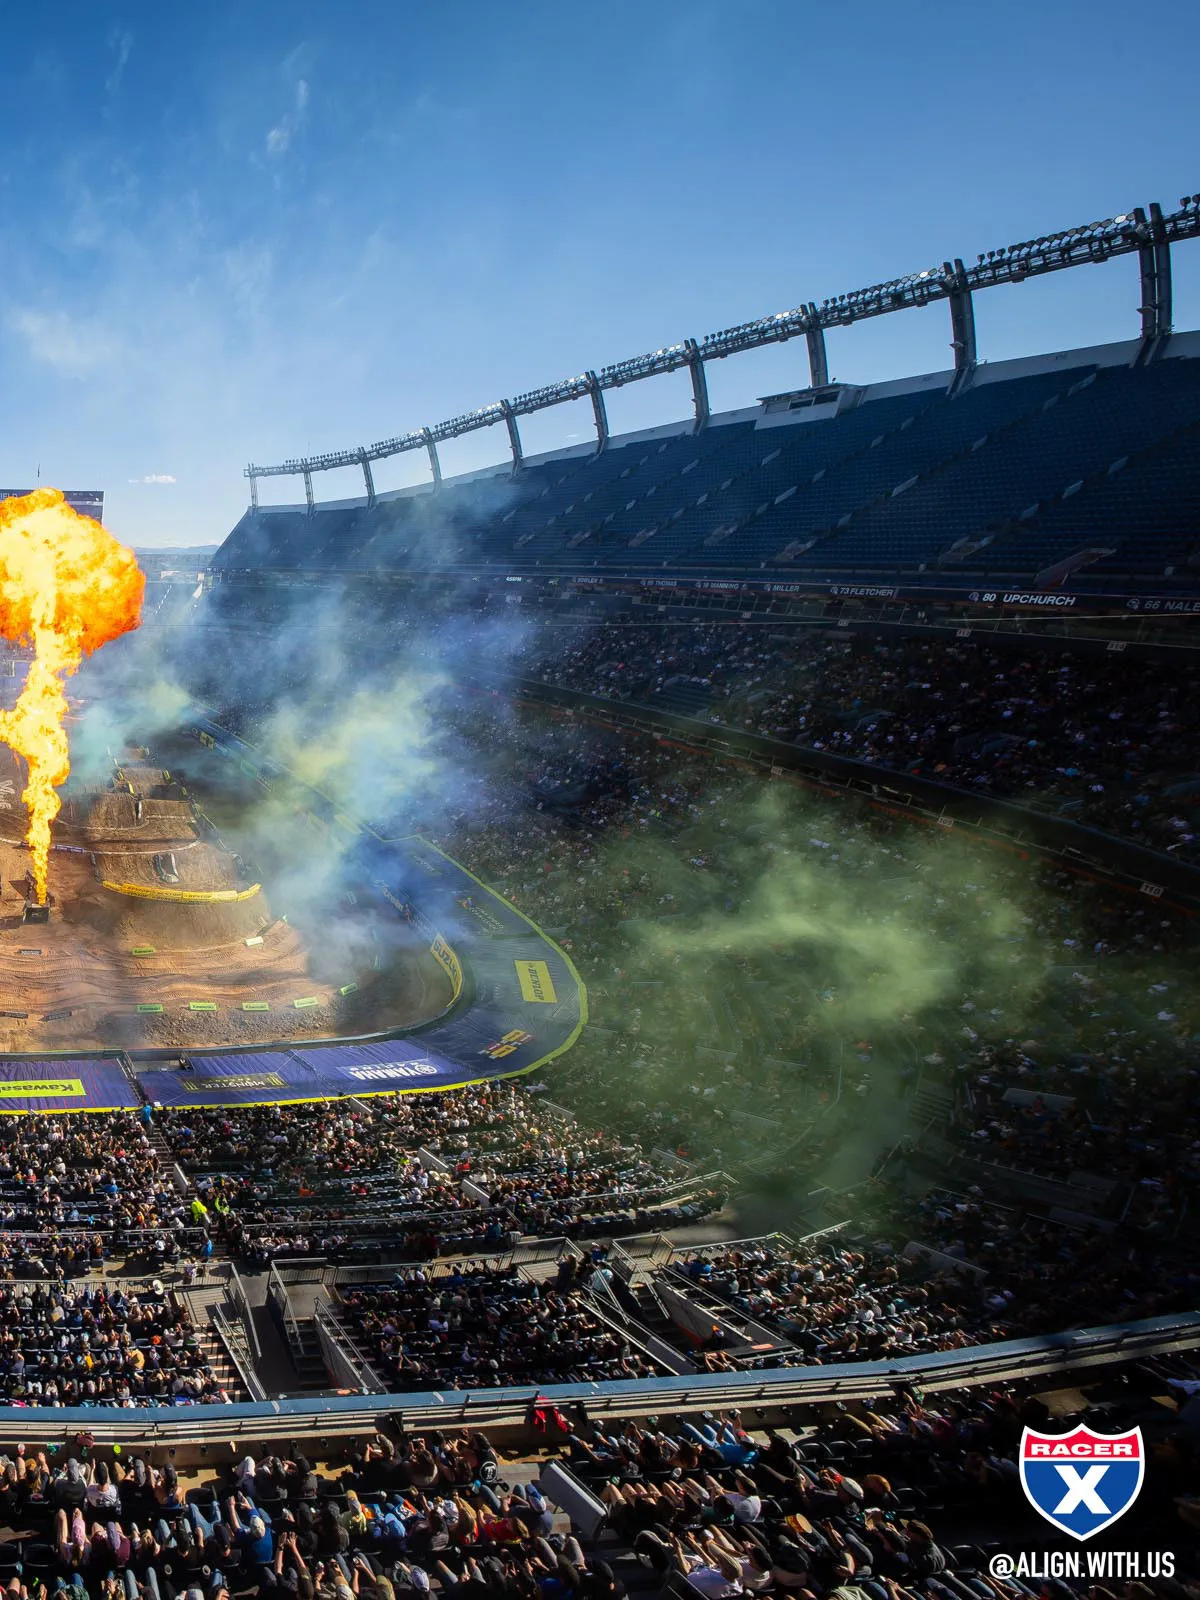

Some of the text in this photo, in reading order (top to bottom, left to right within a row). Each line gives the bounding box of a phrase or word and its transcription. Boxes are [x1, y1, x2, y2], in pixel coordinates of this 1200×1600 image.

[772, 584, 800, 592] MILLER
[840, 587, 894, 597] 73 FLETCHER
[982, 592, 1076, 606] 80 UPCHURCH
[527, 967, 545, 1001] DUNLOP
[348, 1066, 422, 1080] YAMAHA
[201, 1079, 266, 1089] MONSTER
